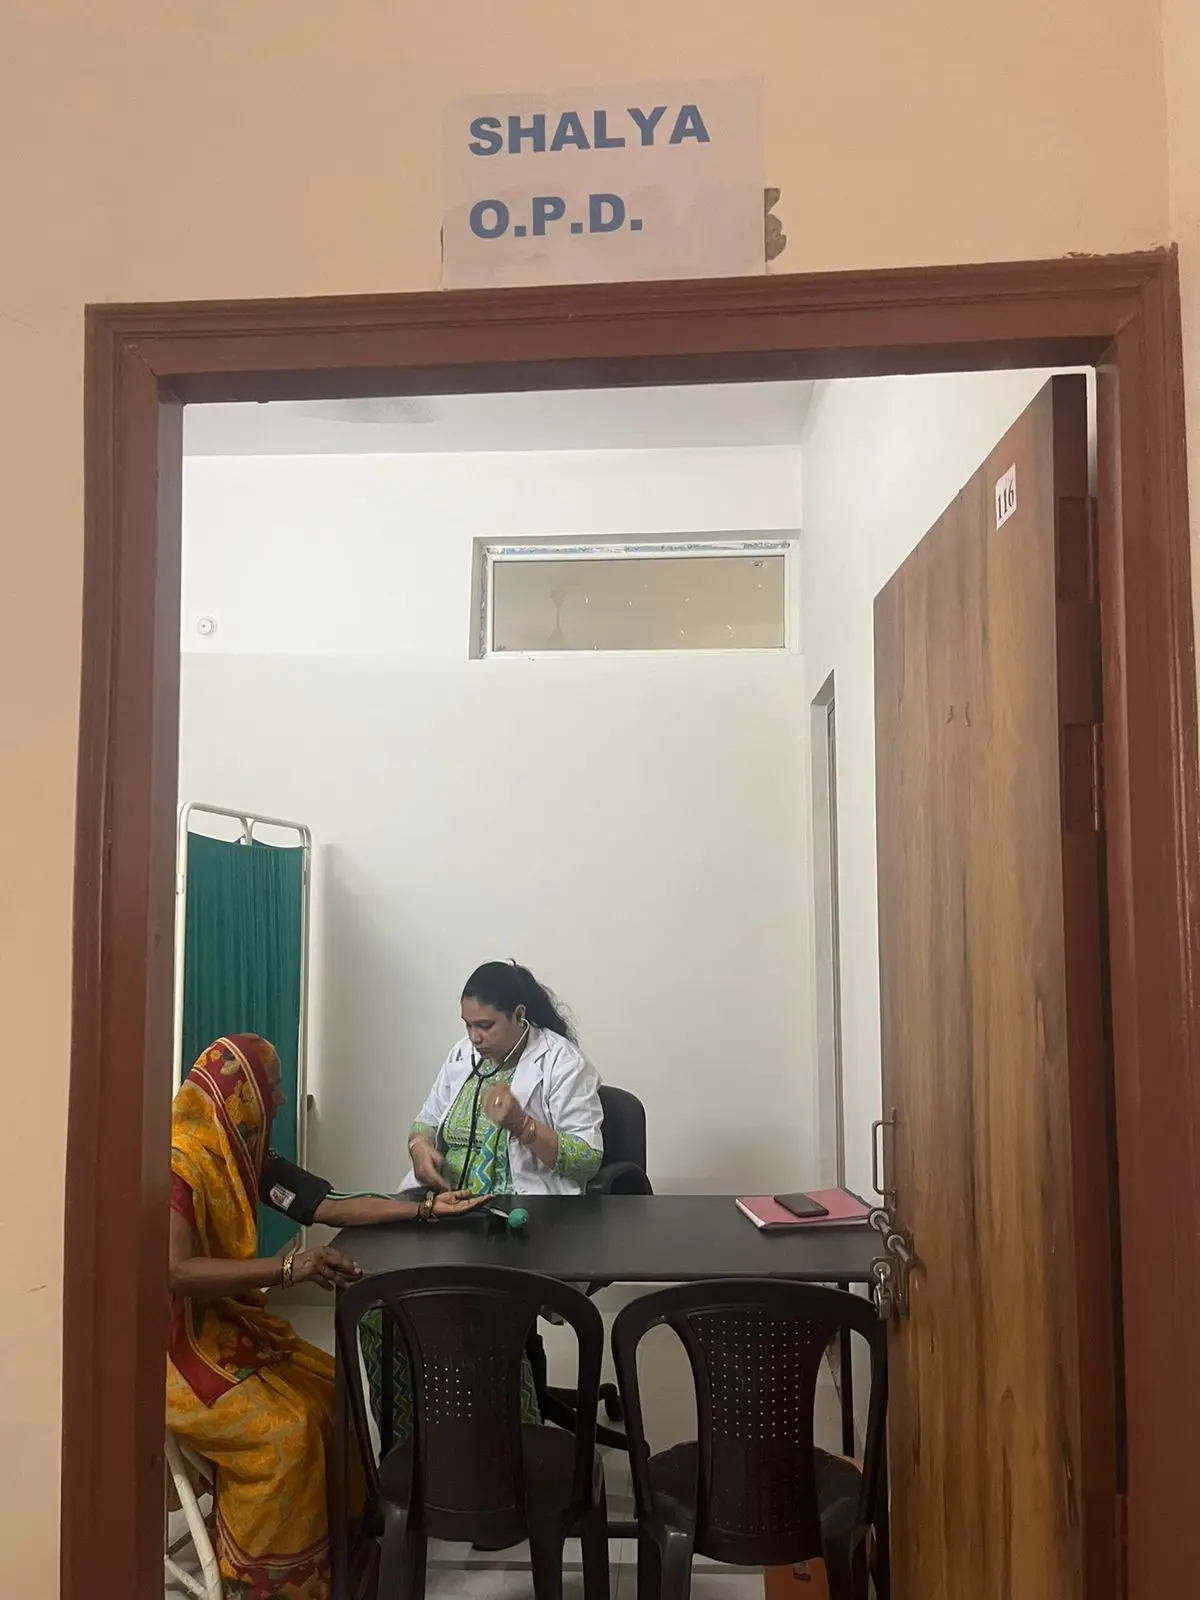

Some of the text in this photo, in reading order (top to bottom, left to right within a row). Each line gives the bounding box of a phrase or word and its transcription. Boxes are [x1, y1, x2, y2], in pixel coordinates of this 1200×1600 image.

[468, 105, 711, 156] SHALYA
[469, 193, 643, 239] O.P.D.
[997, 479, 1015, 520] 116
